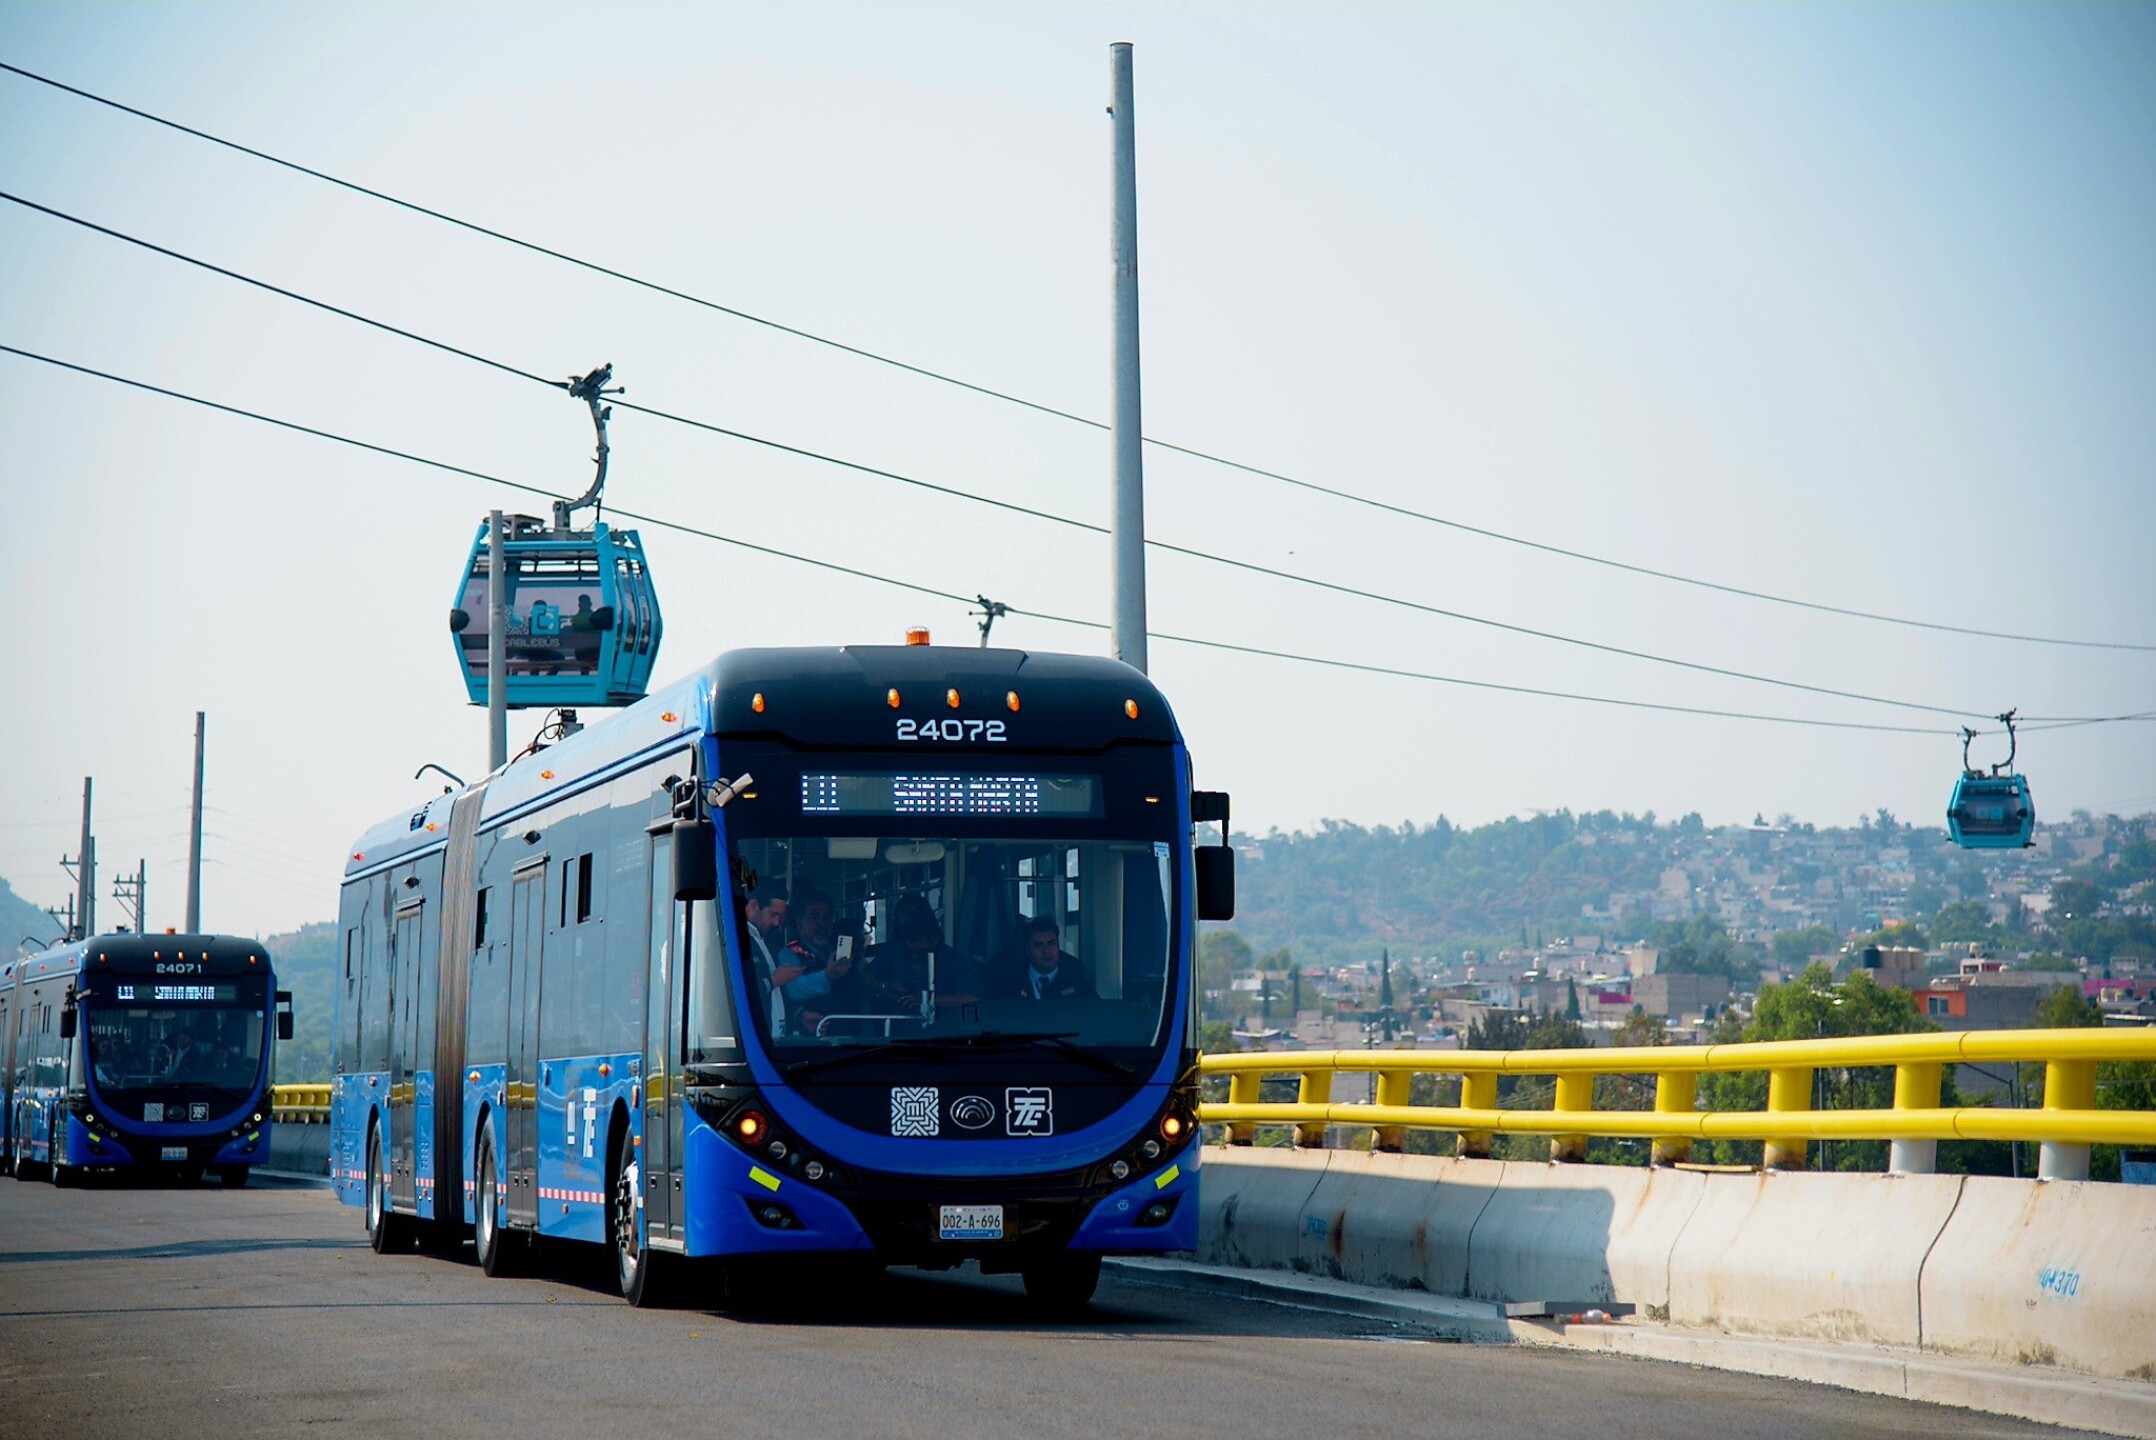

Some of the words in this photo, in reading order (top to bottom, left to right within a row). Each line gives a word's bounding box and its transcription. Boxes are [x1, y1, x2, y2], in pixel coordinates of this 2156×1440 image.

[896, 719, 1007, 741] 24072
[894, 776, 963, 812] SANTA
[156, 963, 202, 974] 24071
[942, 1214, 1001, 1229] 002-A-696
